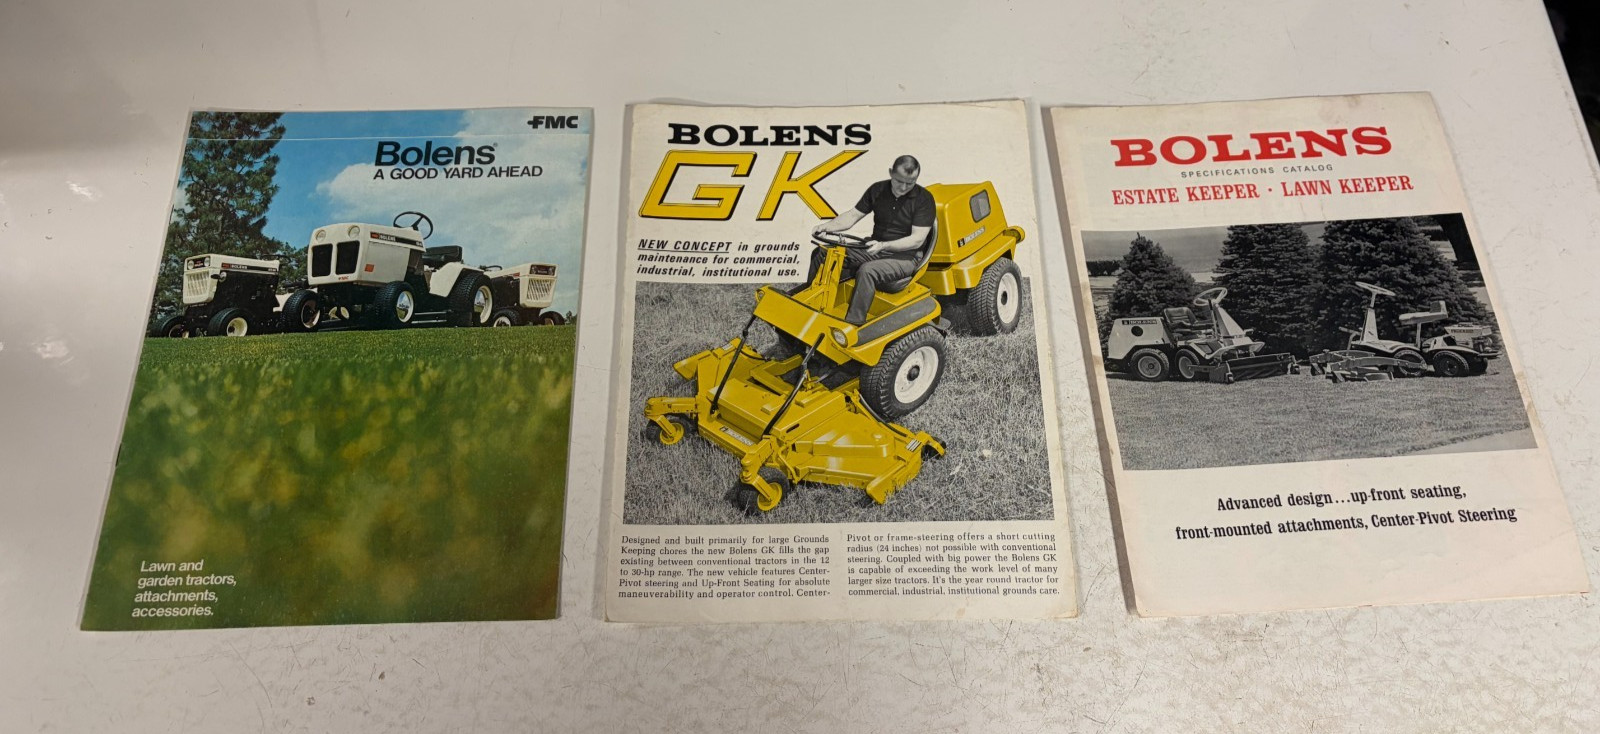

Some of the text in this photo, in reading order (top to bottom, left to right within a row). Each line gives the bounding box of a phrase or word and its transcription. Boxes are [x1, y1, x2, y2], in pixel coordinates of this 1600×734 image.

[527, 116, 578, 129] FMC
[668, 123, 872, 146] BOLENS
[1110, 126, 1392, 167] BOLENS
[373, 166, 543, 180] A GOOD YARD AHEAD
[1180, 164, 1333, 178] SPECIFICATIONS CATALOG
[1112, 175, 1414, 205] ESTATE KEEPER LAWN KEEPER
[638, 239, 800, 253] NEW CONCEPT in grounds
[638, 253, 800, 264] maintenance for commercial,
[637, 265, 799, 277] industrial, institutional use.
[1217, 494, 1282, 511] Advanced
[1410, 484, 1466, 499] seating,
[1175, 507, 1518, 539] front-mounted attachments, Center-Pivot Steering
[622, 535, 829, 546] Designed and built primarily for large Grounds
[847, 534, 871, 542] Pivot
[887, 533, 954, 542] frame-steering
[957, 532, 984, 540] offers
[1023, 532, 1056, 542] cutting
[621, 547, 656, 556] Keeping
[691, 546, 704, 554] the
[729, 546, 757, 554] Bolens
[761, 546, 774, 554] GK
[778, 546, 794, 554] fills
[798, 546, 811, 554] the
[814, 548, 829, 556] gap
[847, 544, 873, 552] radius
[876, 544, 889, 552] (24
[892, 544, 922, 552] inches)
[942, 543, 976, 553] possible
[980, 543, 999, 551] with
[1002, 542, 1056, 551] conventional
[620, 558, 654, 567] existing
[657, 558, 693, 566] between
[697, 557, 751, 566] conventional
[755, 557, 787, 565] tractors
[803, 556, 816, 564] the
[820, 556, 830, 564] 12
[848, 553, 1057, 564] steering. Coupled with big power the Bolens GK
[140, 559, 204, 572] Lawn and
[858, 565, 891, 574] capable
[908, 565, 950, 574] exceeding
[971, 564, 993, 572] work
[998, 564, 1019, 572] level
[1022, 564, 1031, 572] of
[1034, 566, 1058, 574] many
[632, 568, 655, 578] 30-hp
[658, 570, 684, 578] range.
[728, 568, 757, 576] vehicle
[761, 567, 795, 575] features
[798, 567, 830, 575] Center-
[138, 574, 237, 589] garden tractors,
[619, 578, 830, 589] Pivot steering and Up-Front Seating for absolute
[848, 576, 872, 585] larger
[894, 576, 929, 584] tractors.
[932, 575, 946, 583] It's
[949, 575, 962, 583] the
[965, 576, 984, 584] year
[986, 575, 1012, 583] round
[1015, 575, 1043, 583] tractor
[134, 590, 218, 602] attachments,
[618, 588, 830, 599] maneuverability and operator control. Center-
[848, 587, 900, 596] commercial,
[902, 587, 945, 596] industrial,
[948, 586, 1000, 594] institutional
[1003, 586, 1037, 595] grounds
[132, 604, 214, 617] accessories.
